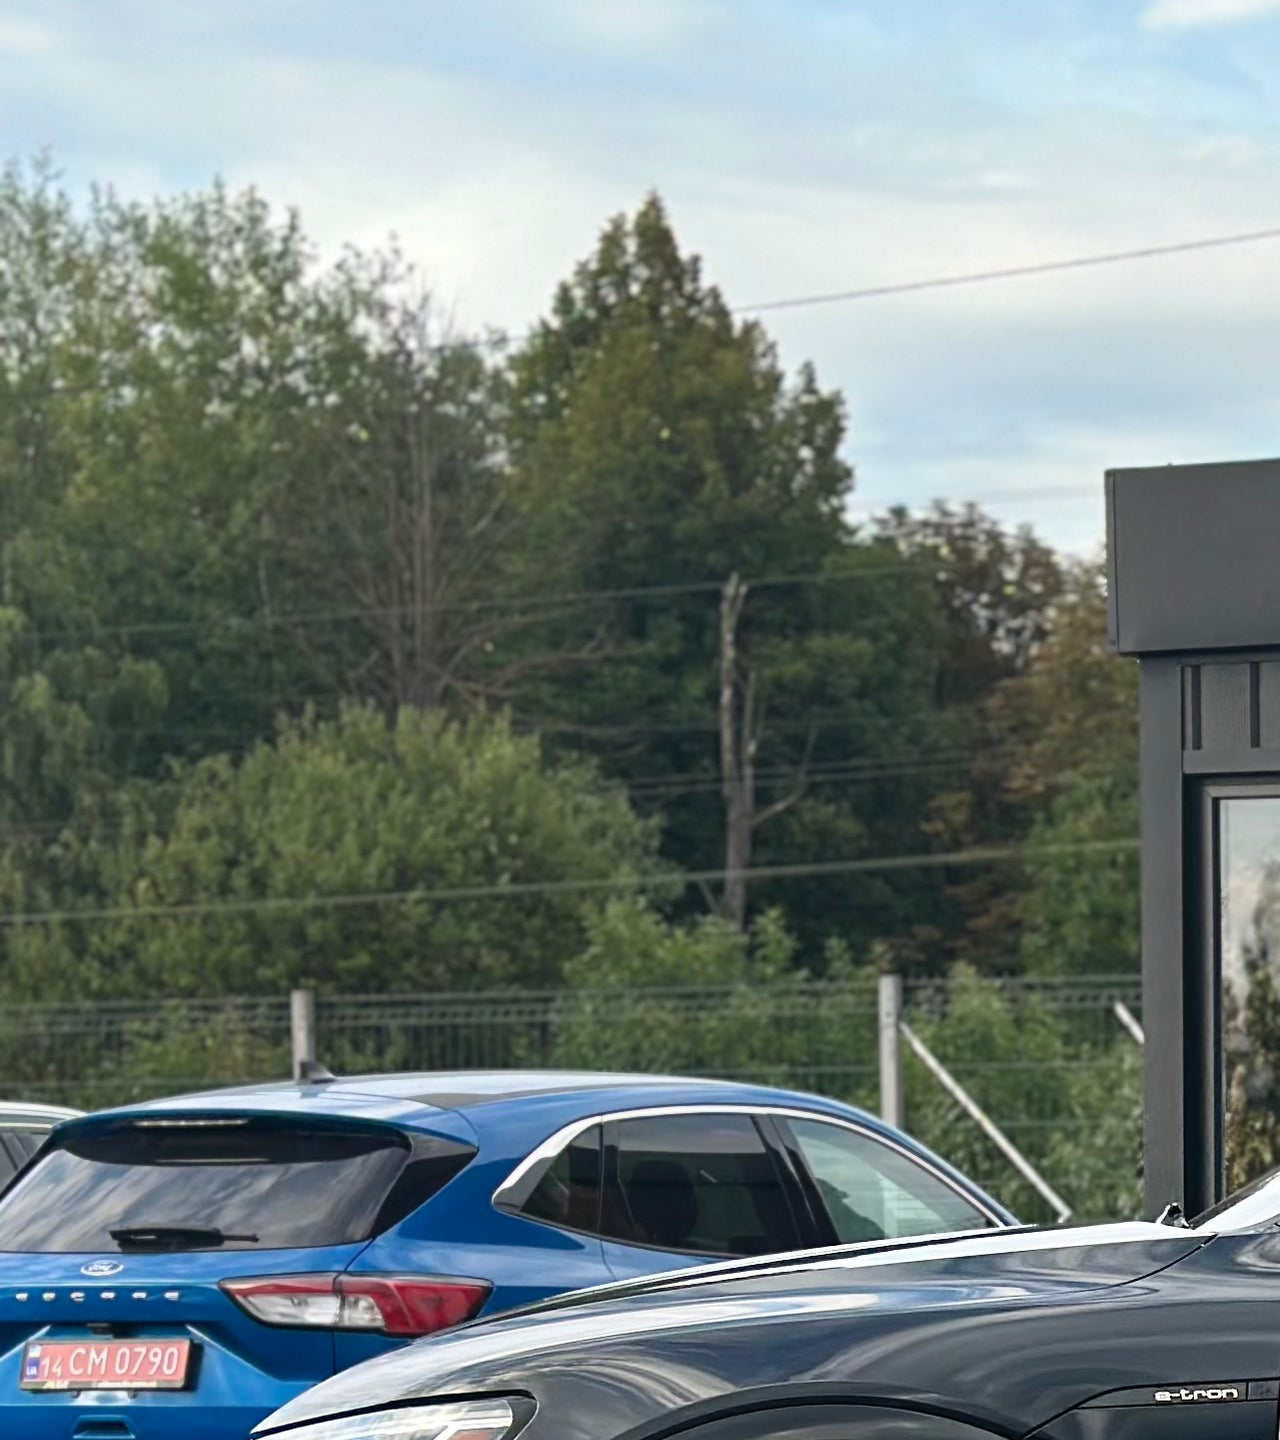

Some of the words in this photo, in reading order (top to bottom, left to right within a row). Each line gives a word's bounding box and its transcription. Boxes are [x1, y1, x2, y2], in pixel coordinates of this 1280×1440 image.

[40, 1356, 63, 1378] 14
[69, 1346, 109, 1376] CM
[114, 1346, 179, 1376] 0790
[1154, 1387, 1239, 1402] e-tron
